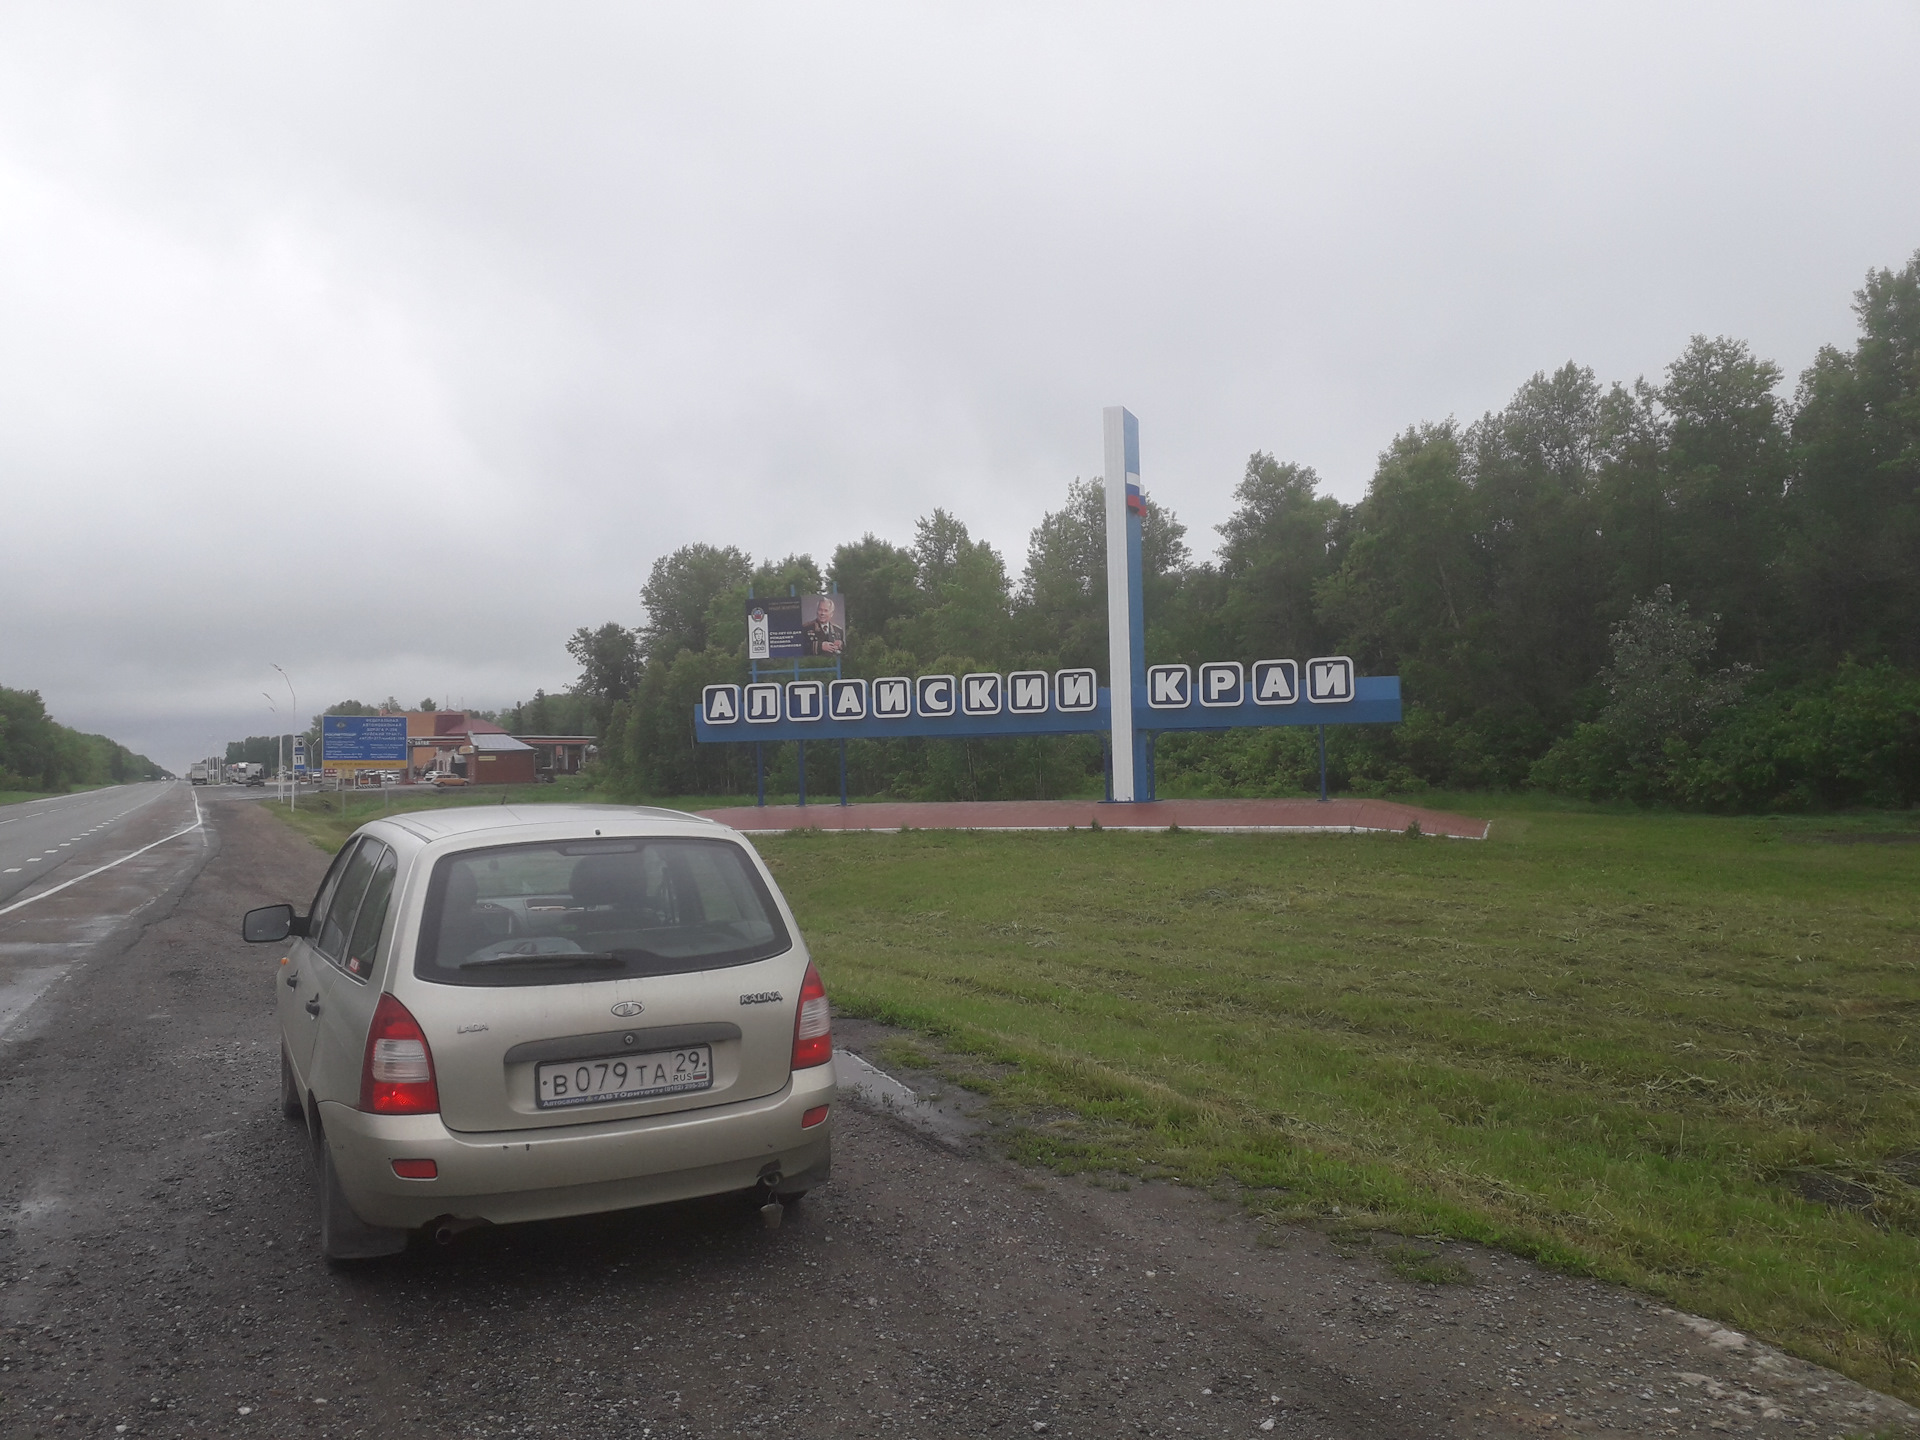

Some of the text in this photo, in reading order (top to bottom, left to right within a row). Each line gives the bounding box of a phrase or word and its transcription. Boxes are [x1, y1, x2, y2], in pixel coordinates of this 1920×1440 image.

[709, 663, 1346, 718] АЛТАЙСКИЙ КРАЙ
[740, 991, 783, 1005] KALINA
[456, 1022, 489, 1034] LADA
[675, 1051, 700, 1072] 29
[673, 1072, 692, 1082] RUS
[543, 1098, 585, 1106] Автосалон
